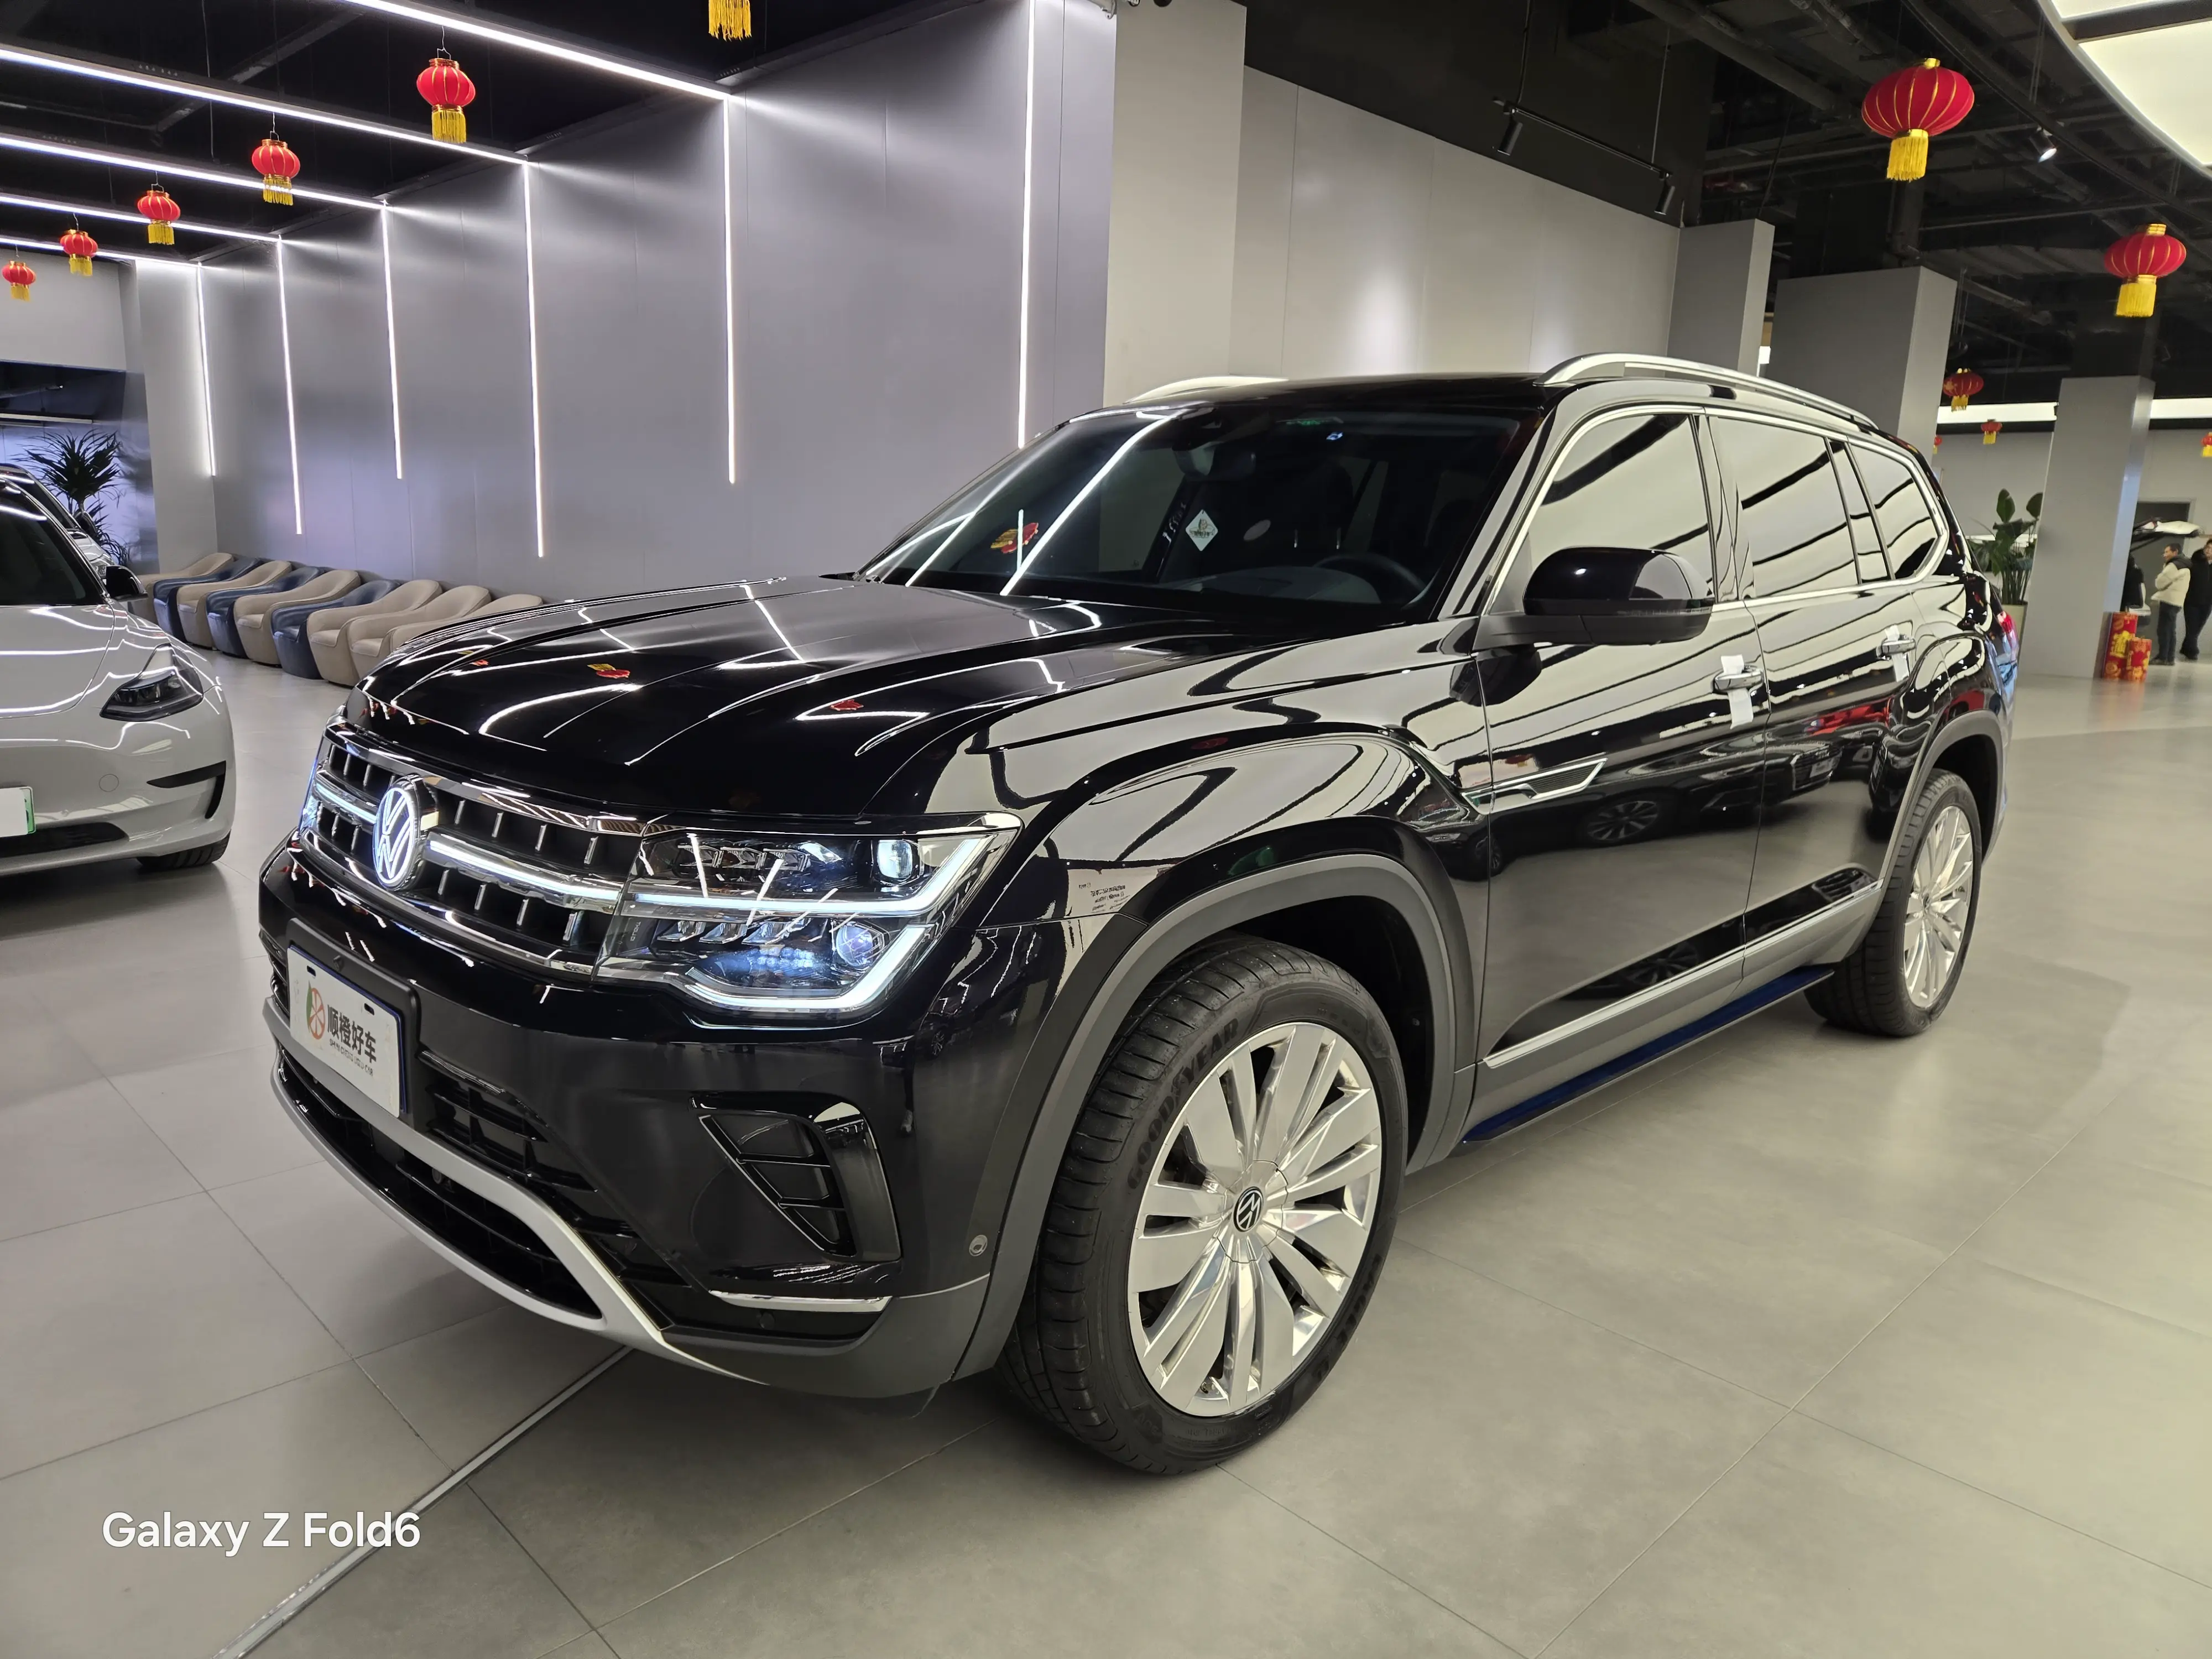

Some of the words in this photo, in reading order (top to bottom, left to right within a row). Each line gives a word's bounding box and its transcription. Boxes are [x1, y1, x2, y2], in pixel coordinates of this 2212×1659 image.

[327, 1004, 377, 1063] 顺橙好车
[1127, 1018, 1239, 1190] GOODYEAR
